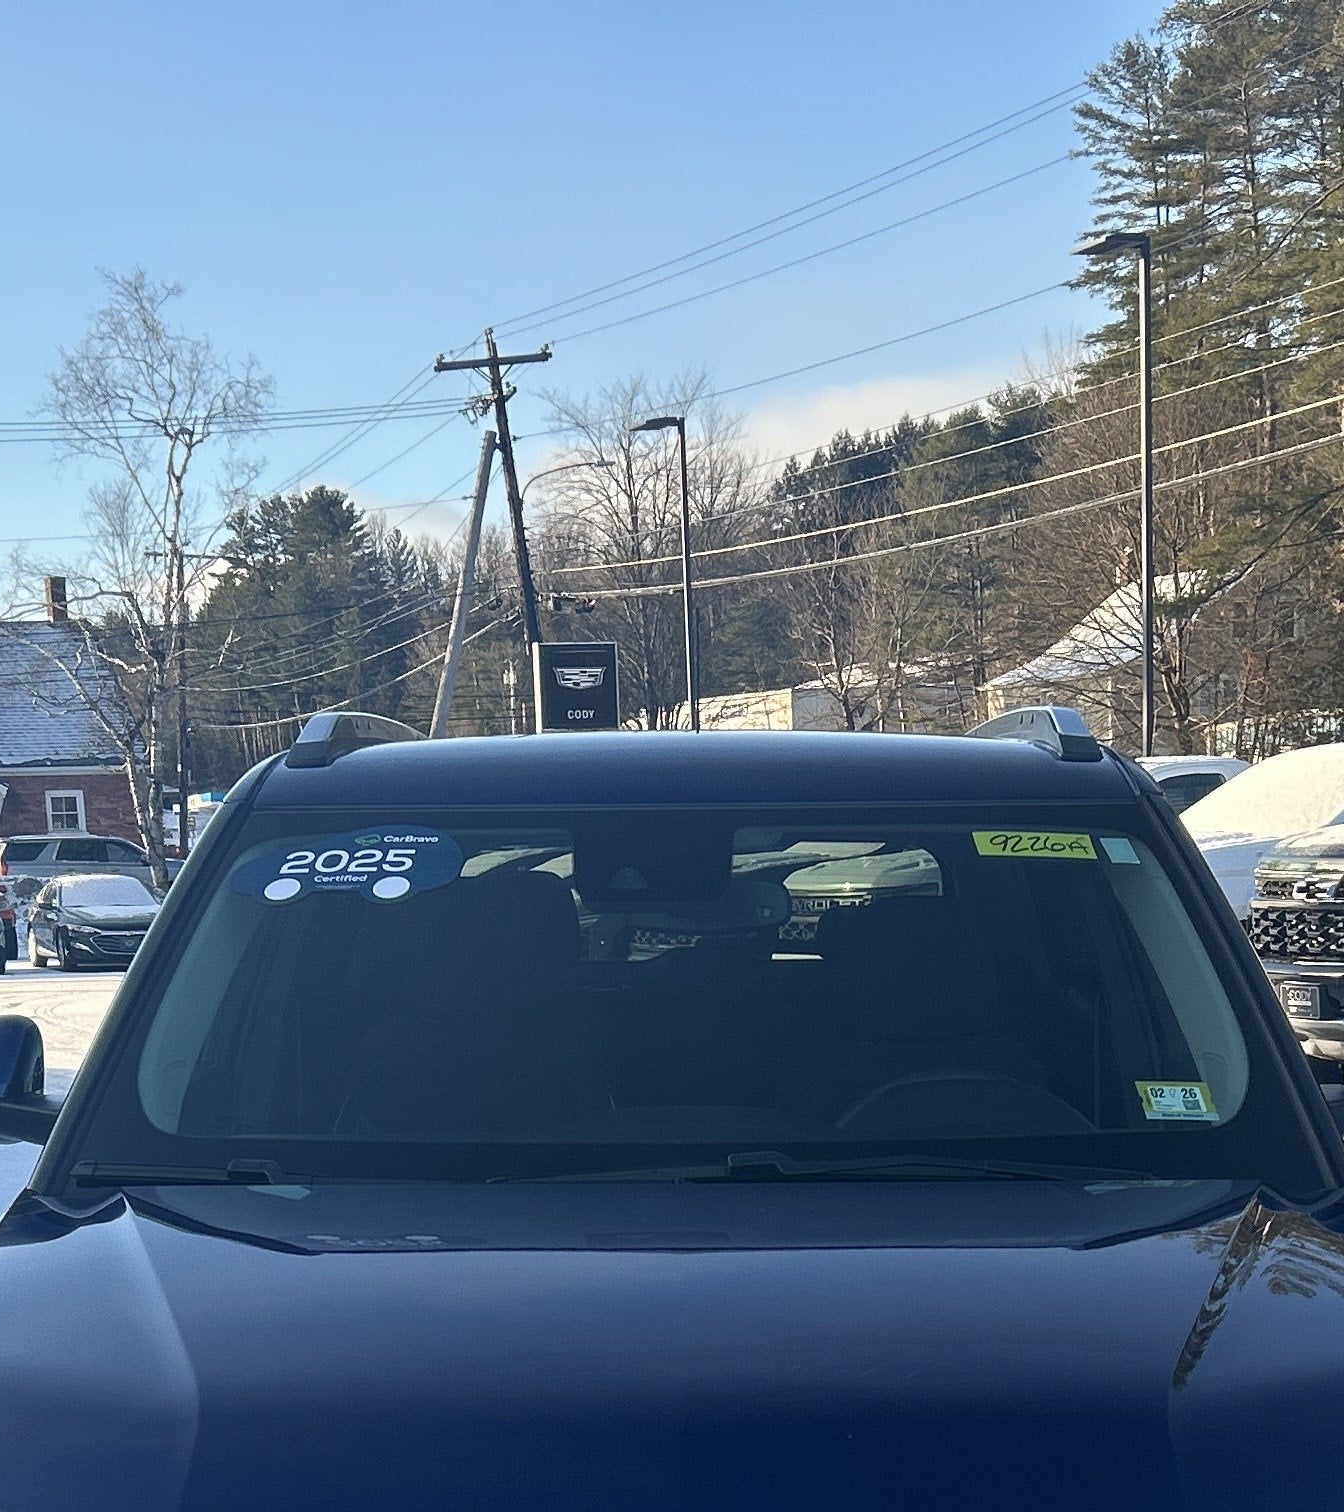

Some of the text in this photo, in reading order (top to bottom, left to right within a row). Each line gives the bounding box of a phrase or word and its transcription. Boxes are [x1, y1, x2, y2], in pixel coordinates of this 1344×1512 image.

[567, 709, 595, 720] CODY
[383, 835, 439, 843] CarBravo
[279, 849, 416, 875] 2025
[314, 874, 369, 883] Certified
[1180, 1087, 1197, 1099] 26
